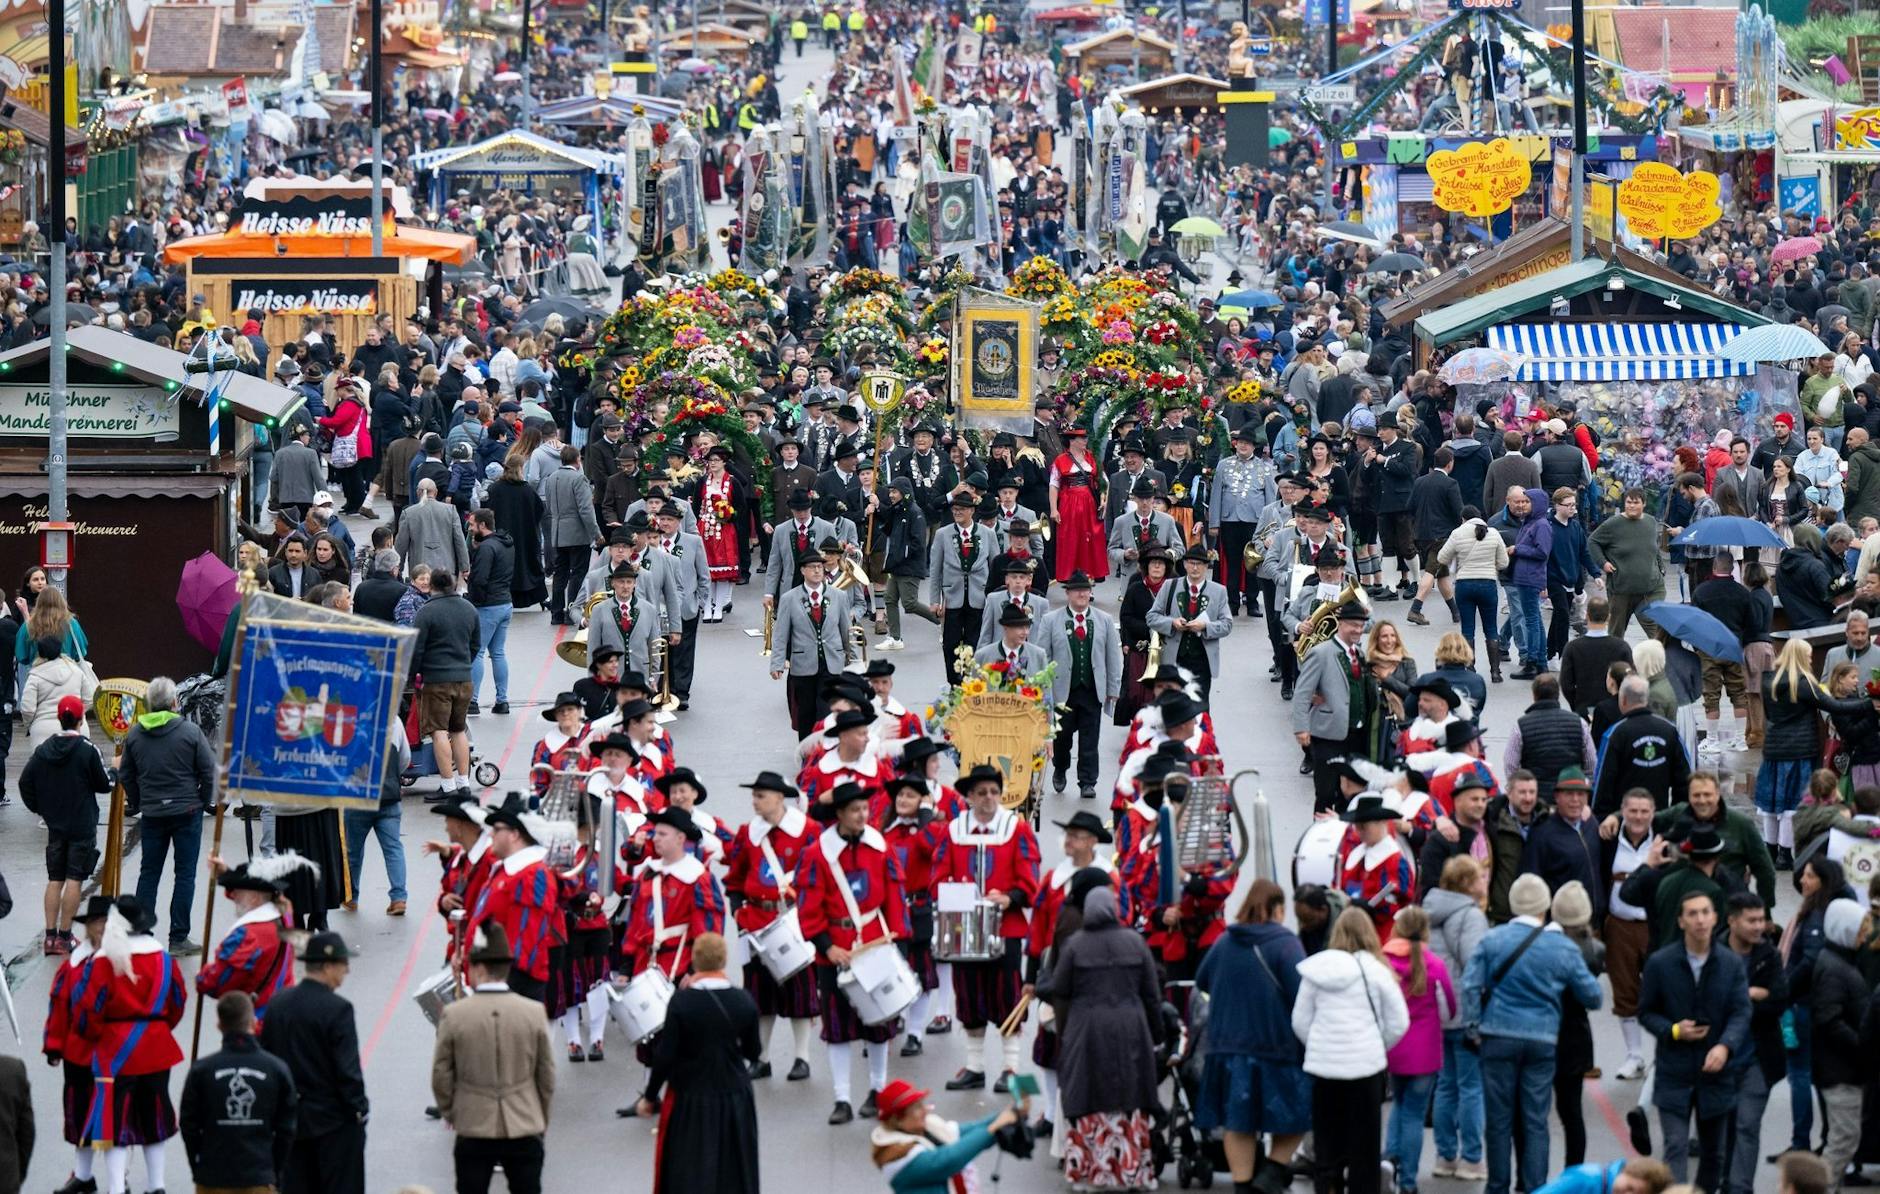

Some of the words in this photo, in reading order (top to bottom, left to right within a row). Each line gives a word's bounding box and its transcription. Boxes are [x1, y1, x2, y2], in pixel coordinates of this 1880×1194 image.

[240, 211, 313, 235] Heisse
[237, 289, 308, 312] Heisse
[308, 288, 371, 312] Nüsse
[25, 391, 111, 407] Mühner
[0, 413, 139, 431] Manderennerei
[23, 504, 71, 517] Hels
[27, 520, 138, 536] Mlbrennerei
